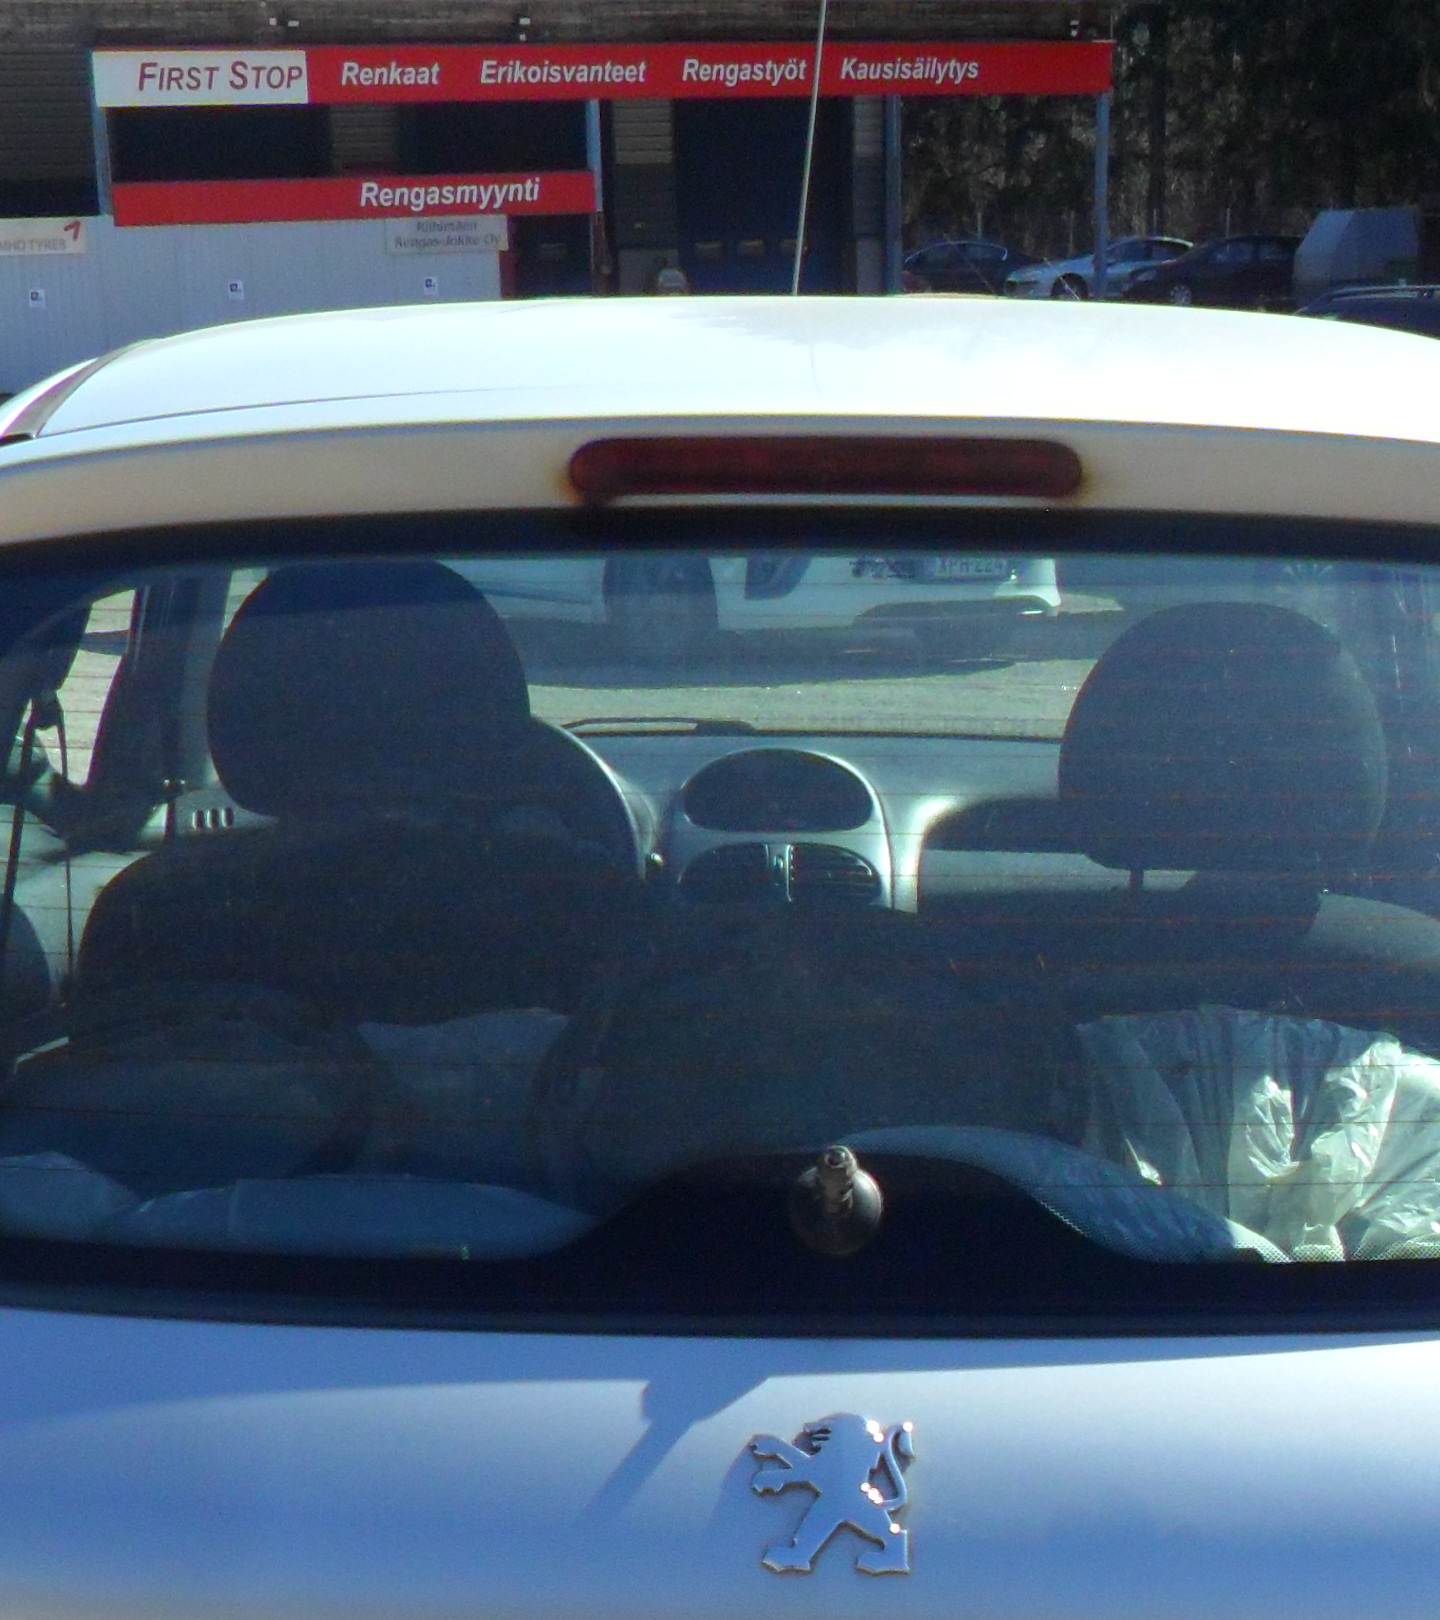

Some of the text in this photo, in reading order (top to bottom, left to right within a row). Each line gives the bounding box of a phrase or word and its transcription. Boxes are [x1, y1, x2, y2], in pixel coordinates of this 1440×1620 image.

[138, 59, 303, 91] FIRST STOP
[341, 56, 979, 86] Renkaat Erikoisvanteet Rengastyöt Kausisäilytys
[360, 177, 540, 211] Rengasmyynti
